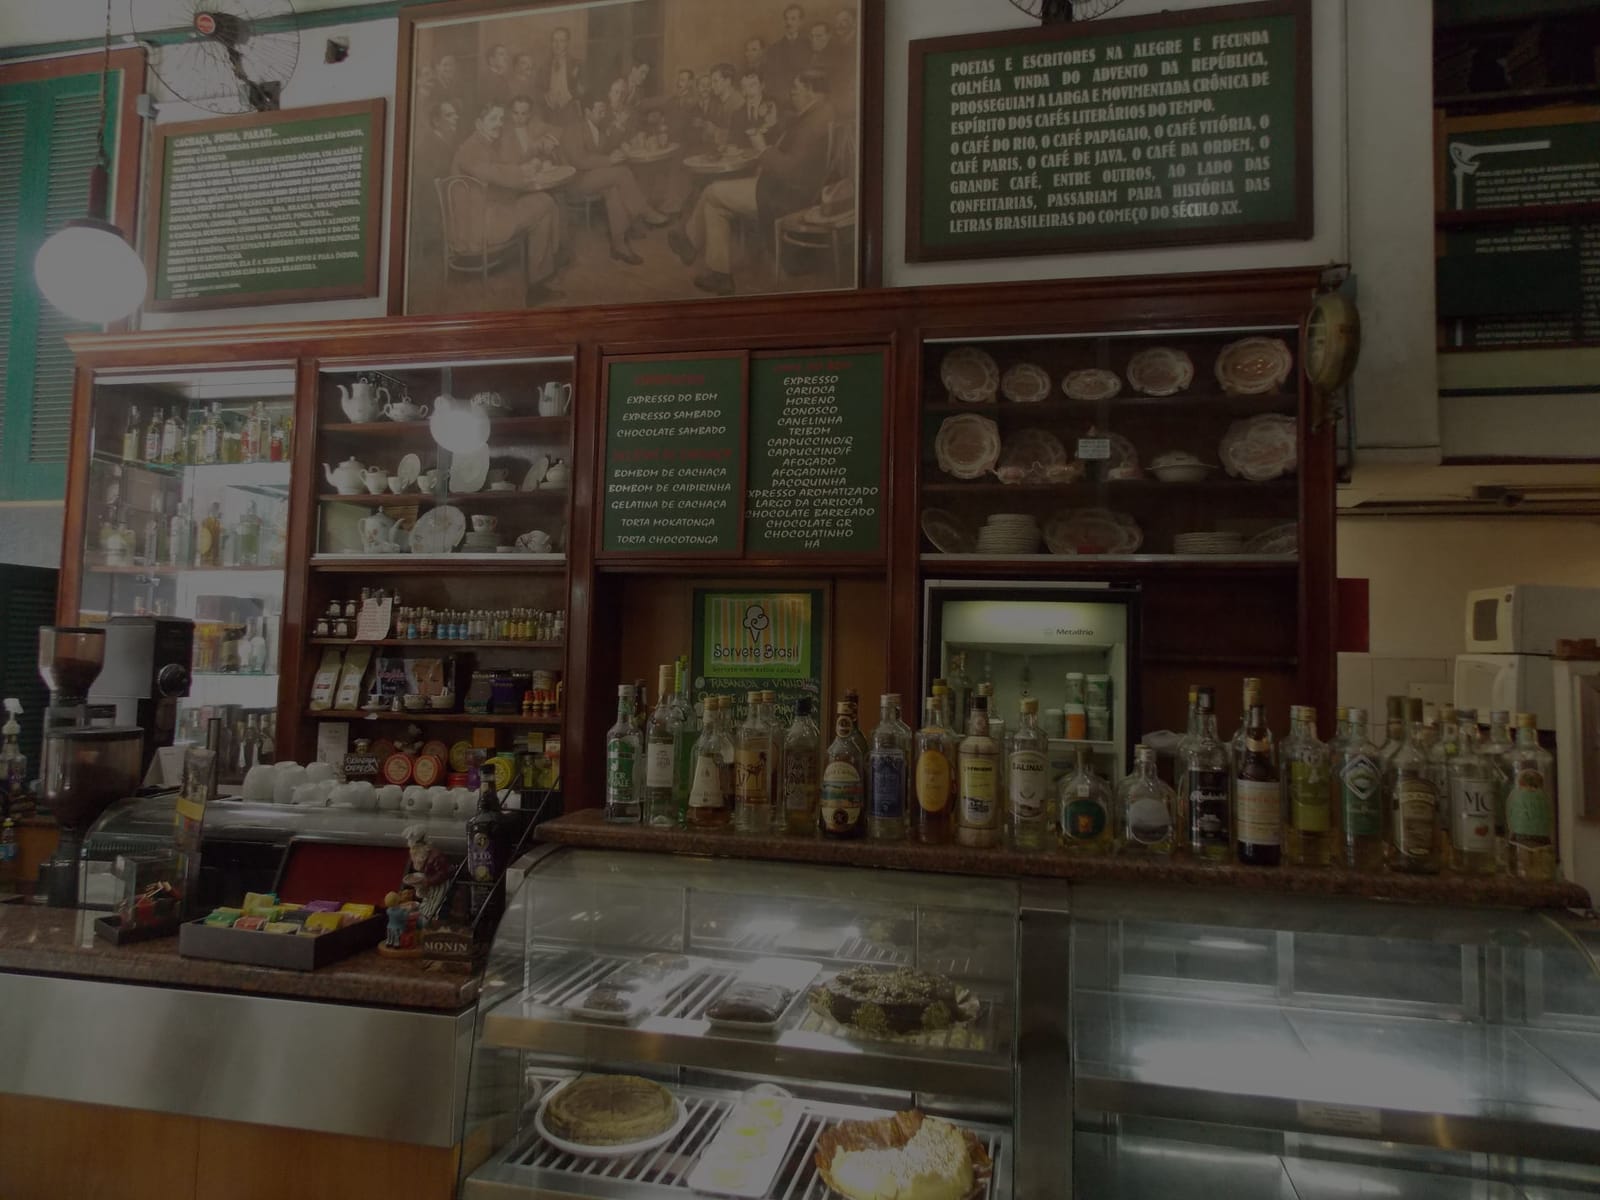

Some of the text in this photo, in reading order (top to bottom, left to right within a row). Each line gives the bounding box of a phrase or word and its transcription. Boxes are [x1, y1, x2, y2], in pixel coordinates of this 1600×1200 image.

[951, 30, 1270, 77] POETAS E ESCRITORES NA ALEGRE E FECUNDA
[950, 52, 1268, 96] COLMÉIA VINDA DO ADVENTO DA REPÚBLICA,
[951, 72, 1270, 116] PROSSEGUIAM A LARGA E MOVIMENTADA CRÔNICA DE
[951, 99, 1215, 135] ESPÍRITO DOS CAFÉS LITERÁRIOS DO TEMPO.
[950, 114, 1270, 155] O CAFÉ DO RIO, O CAFÉ PAPAGAIO, O CAFÉ VITÓRIA, O
[950, 136, 1270, 174] CAFÉ PARIS, O CAFÉ DE JAVA, O CAFÉ DA ORDEM, O
[950, 156, 1270, 194] GRANDE CAFÉ, ENTRE OUTROS, AO LADO DAS
[950, 177, 1270, 214] CONFEITARIAS, PASSARIAM PARA HISTÓRIA DAS
[950, 200, 1242, 233] LETRAS BRASILEIRAS DO COMEÇO DO SÉCULO XX.
[784, 376, 839, 386] EXPRESSO
[786, 385, 835, 395] CARIOCA
[626, 393, 718, 404] EXPRESSO DO BOM
[786, 396, 835, 406] MORENO
[622, 410, 721, 421] EXPRESSO SAMBADO
[782, 406, 838, 416] CONOSCO
[777, 416, 842, 426] CANELINHA
[678, 426, 726, 436] SAMBADO
[789, 427, 830, 436] TRIBOM
[782, 457, 836, 467] AFOGADO
[614, 468, 726, 478] BOMBOM DE CACHAÇA
[772, 467, 846, 477] AFOGADINHO
[608, 483, 731, 492] BOMBOM DE CAIPIRINHA
[799, 487, 878, 497] AROMATIZADO
[611, 500, 726, 510] GELATINA DE CACHAÇA
[756, 498, 863, 508] LARGO DA CARIOCA
[814, 508, 875, 517] BARREADO
[621, 518, 650, 526] TORTA
[766, 519, 852, 528] CHOCOLATE GR
[764, 529, 854, 539] CHOCOLATINHO
[617, 536, 720, 544] TORTA CHOCOTONGA
[714, 643, 799, 659] Sorvete Brasil
[423, 941, 468, 952] MONIN
